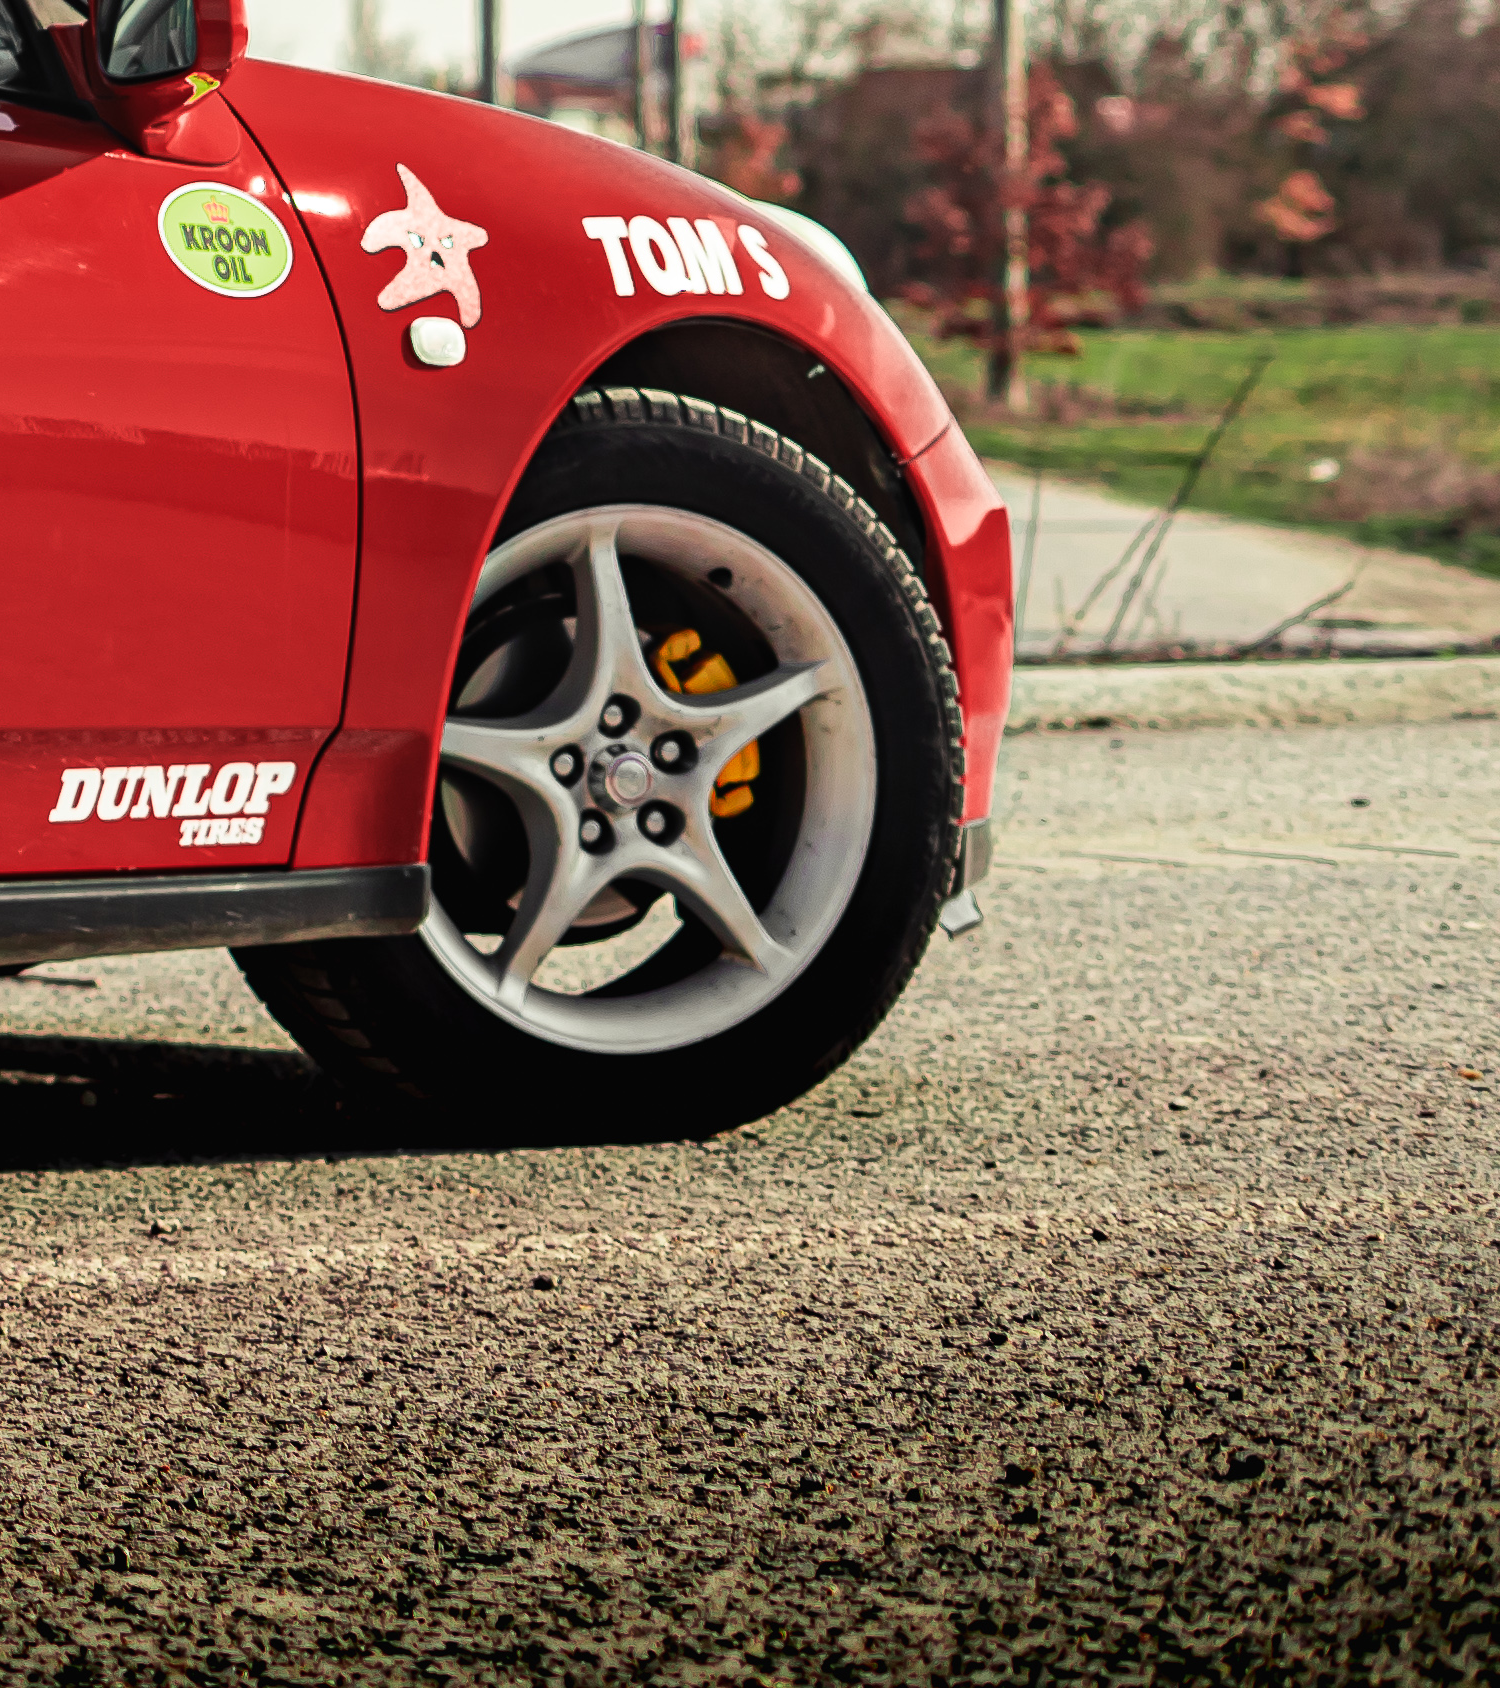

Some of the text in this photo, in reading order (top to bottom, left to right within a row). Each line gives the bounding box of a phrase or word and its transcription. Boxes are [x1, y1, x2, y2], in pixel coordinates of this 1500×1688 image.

[179, 223, 271, 256] KROON
[212, 254, 253, 284] OIL
[48, 761, 297, 823] DUNLOP
[179, 816, 266, 847] TIRES
